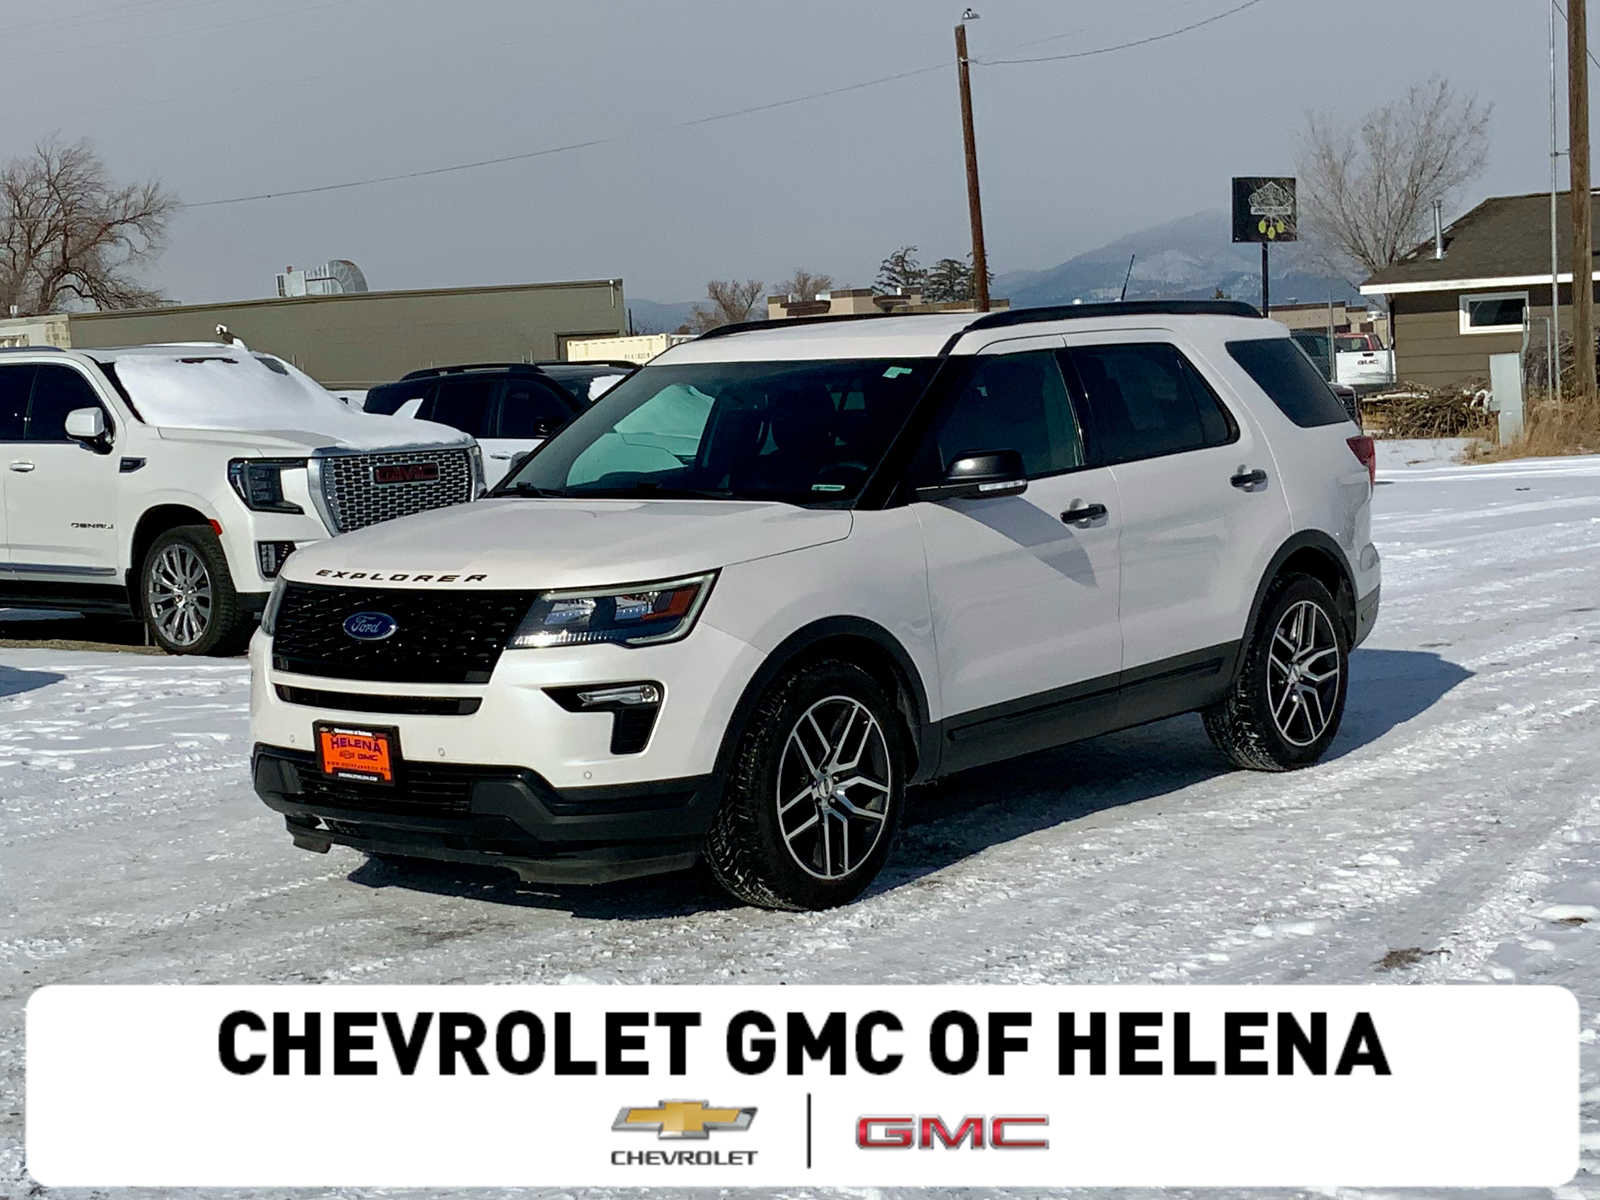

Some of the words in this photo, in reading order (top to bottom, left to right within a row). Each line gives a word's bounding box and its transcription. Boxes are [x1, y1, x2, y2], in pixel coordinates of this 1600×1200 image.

[375, 463, 439, 483] GMC
[71, 522, 114, 530] DENALI
[315, 569, 488, 583] EXPLORER
[350, 614, 382, 633] Ford
[330, 737, 383, 756] HELENA
